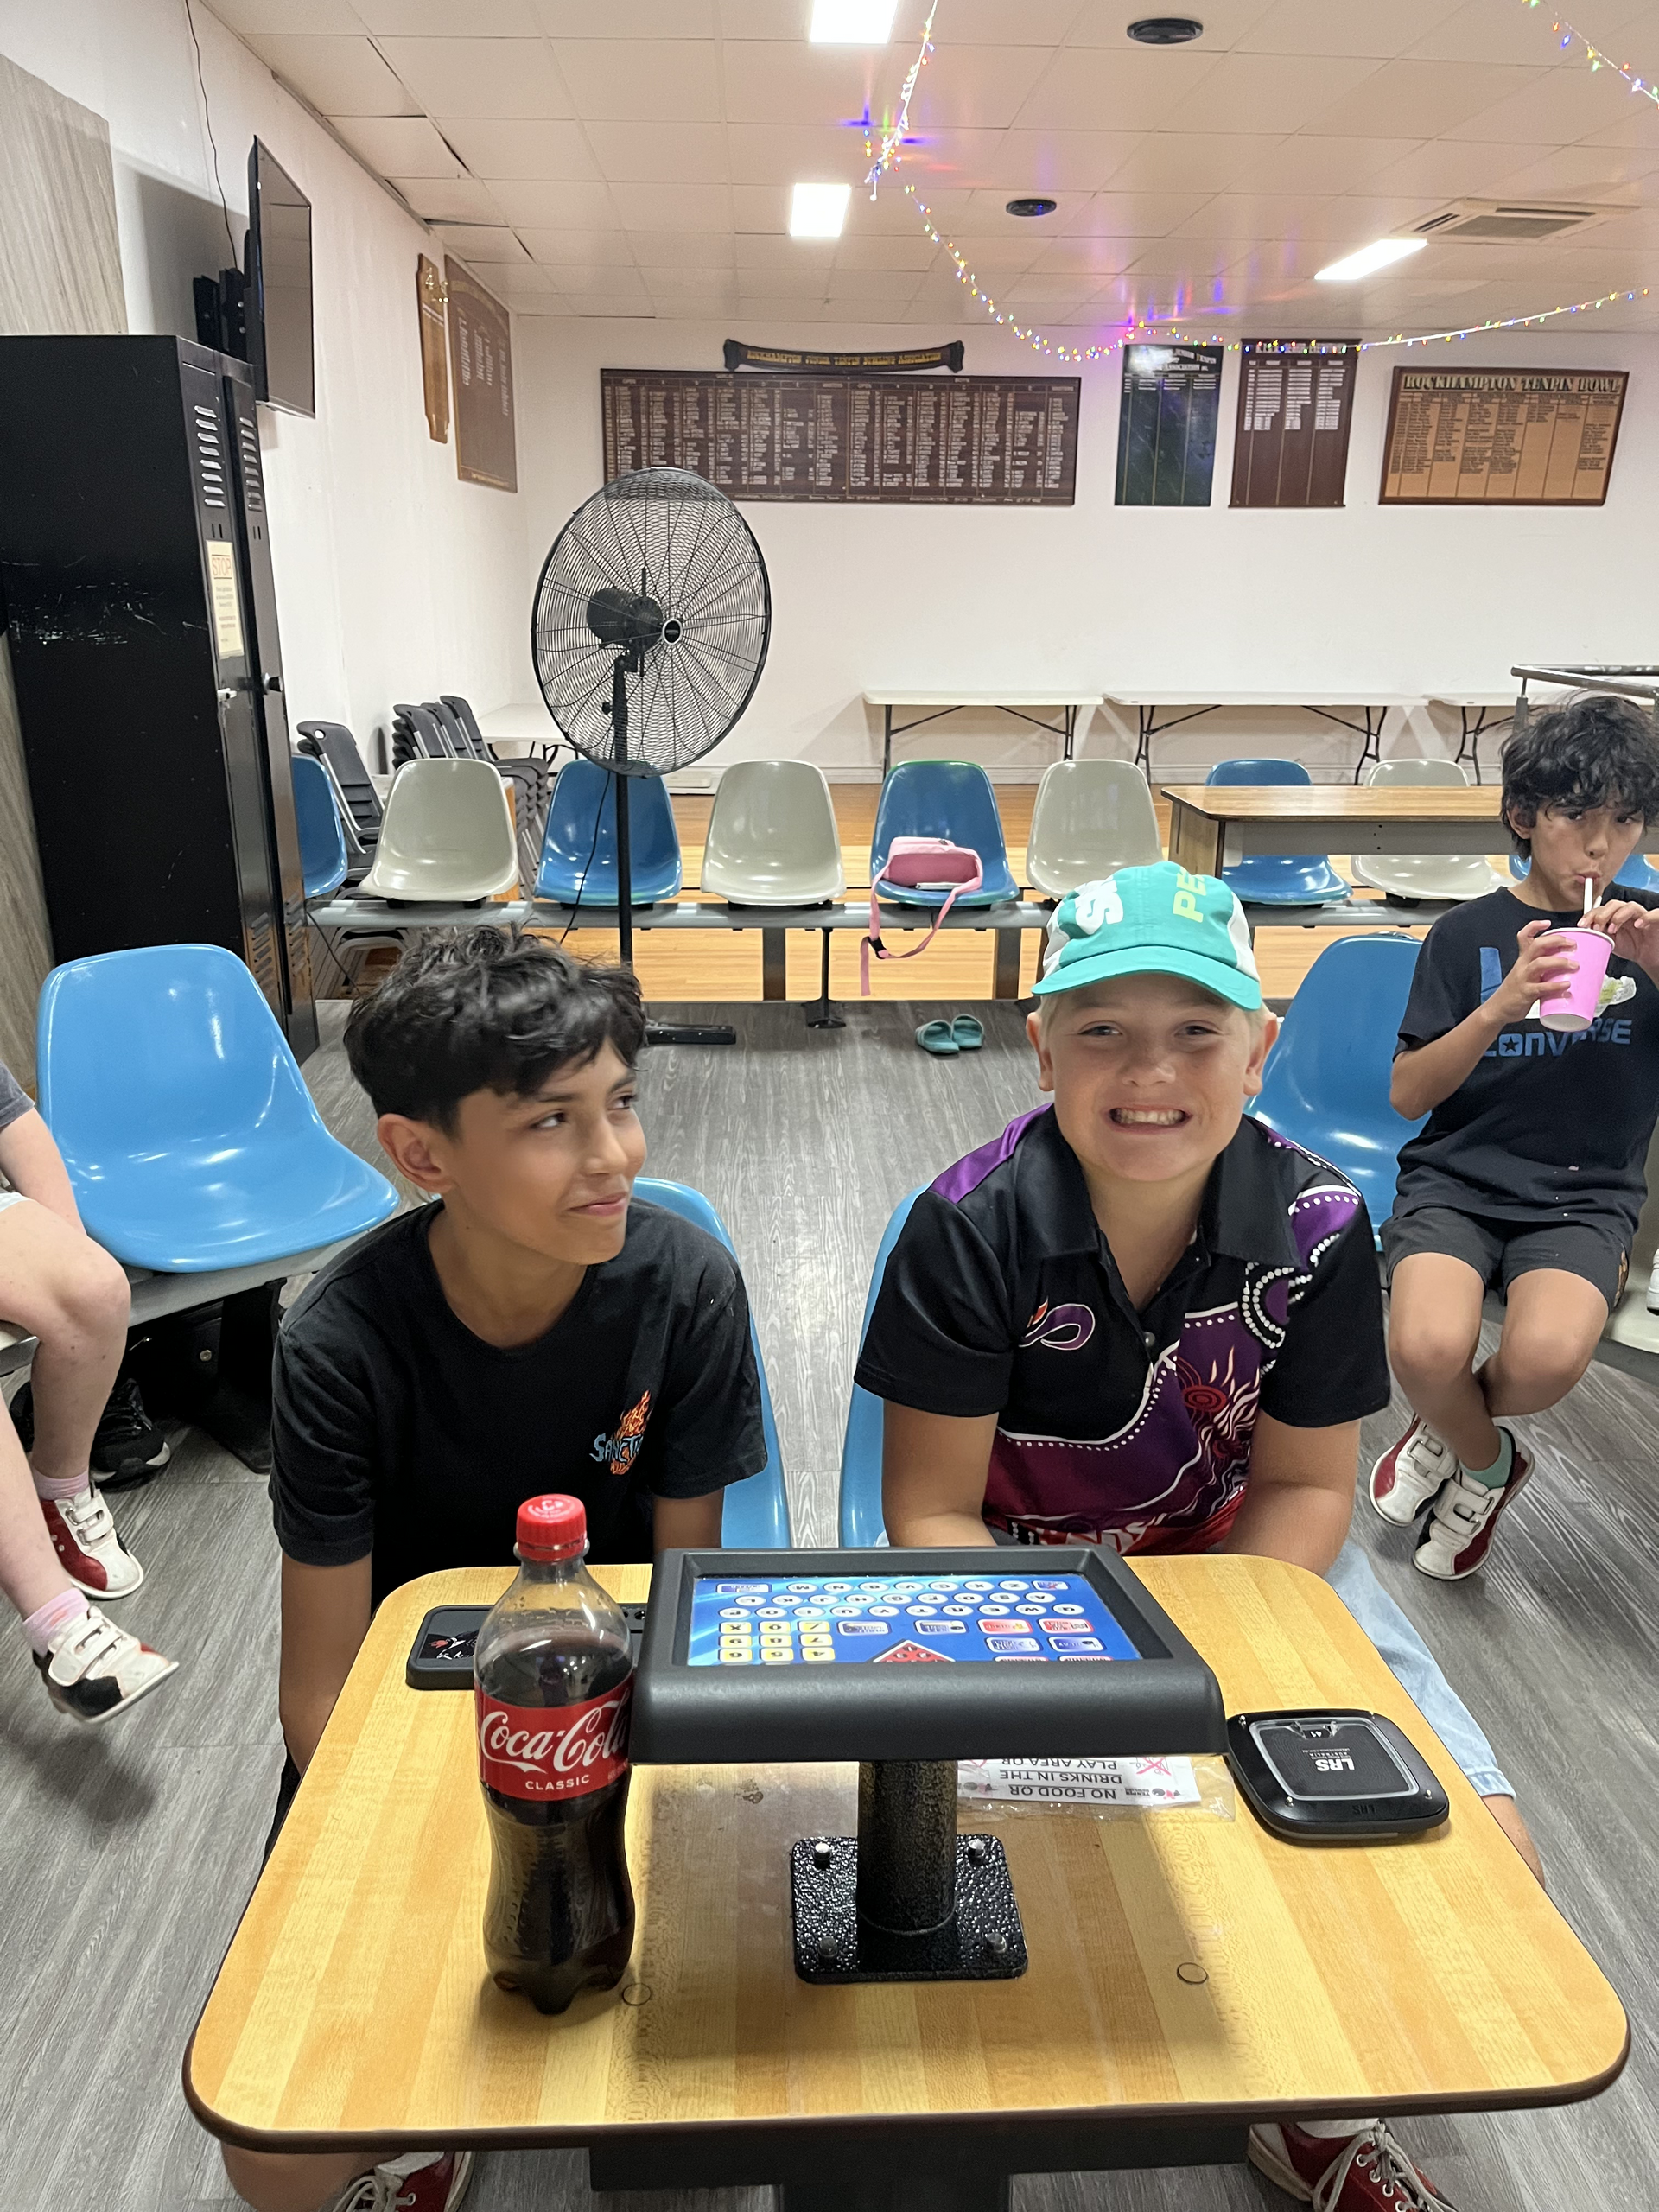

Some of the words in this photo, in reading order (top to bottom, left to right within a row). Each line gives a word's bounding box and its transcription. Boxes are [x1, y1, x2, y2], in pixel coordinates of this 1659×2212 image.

[1403, 375, 1516, 391] ROCKHAMPTON
[1521, 376, 1574, 392] TENPIN
[1577, 377, 1622, 394] BOWL
[212, 557, 232, 577] STOP
[480, 1688, 629, 1774] Coca-Cola
[1029, 1758, 1071, 1767] AREA
[1077, 1760, 1117, 1770] PLAY
[1315, 1758, 1355, 1772] LRS
[999, 1770, 1033, 1781] THE
[1038, 1772, 1054, 1782] IN
[1059, 1772, 1122, 1784] DRINKS
[525, 1774, 589, 1791] CLASSIC
[1008, 1785, 1033, 1796] OR
[1038, 1787, 1086, 1798] FOOD
[1090, 1789, 1116, 1799] NO
[1351, 1804, 1376, 1814] LRS
